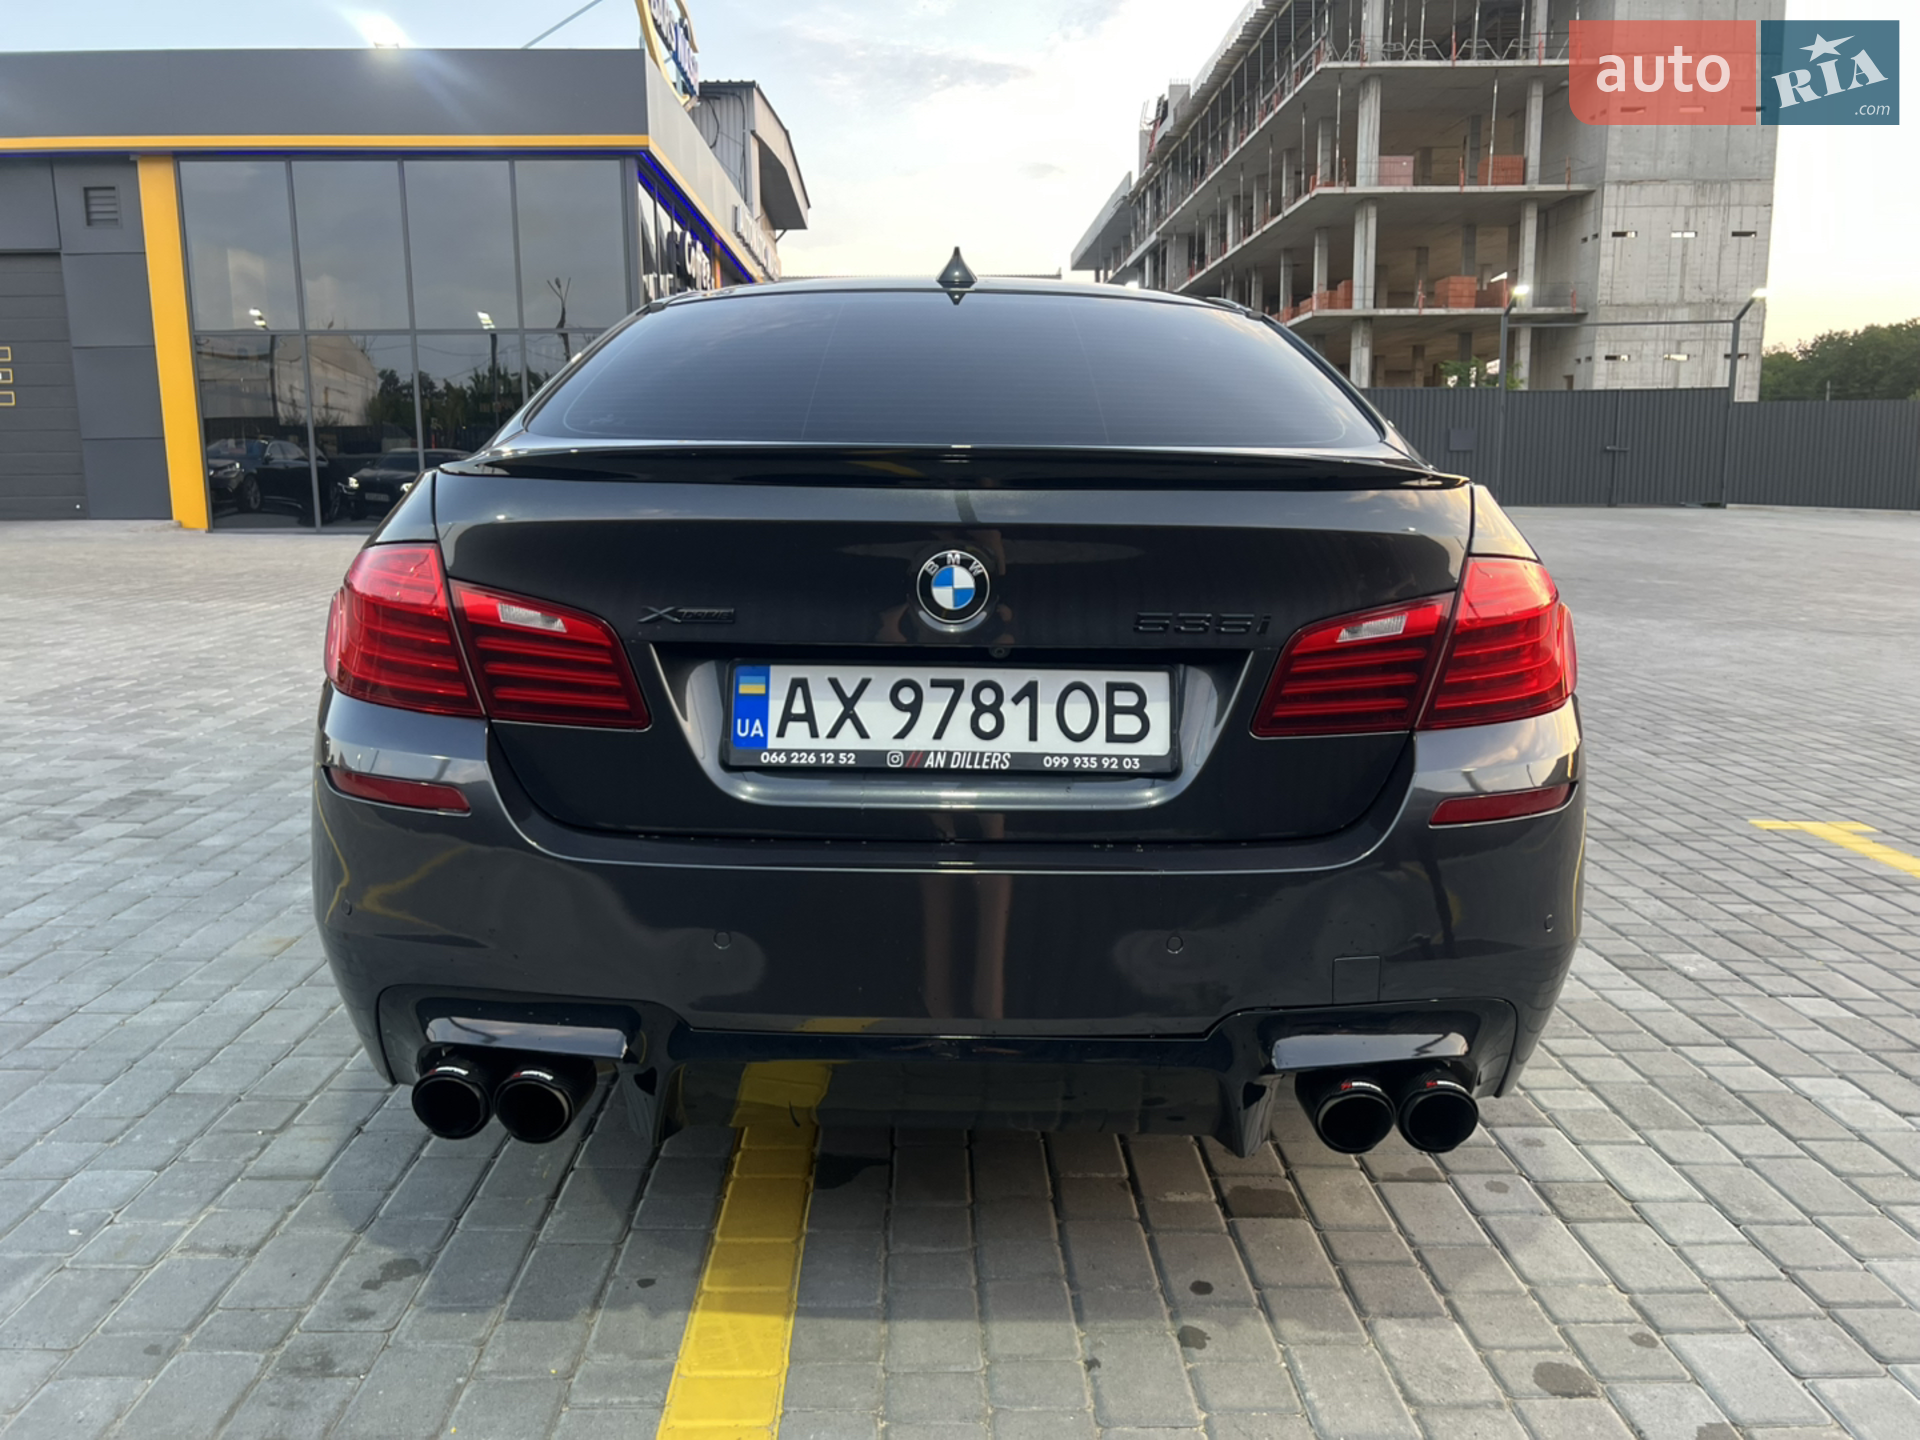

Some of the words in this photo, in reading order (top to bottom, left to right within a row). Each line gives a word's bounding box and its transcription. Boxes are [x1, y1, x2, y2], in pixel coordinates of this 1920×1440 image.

[924, 552, 984, 576] BMW
[776, 677, 872, 739] AX
[889, 678, 1038, 742] 9781
[737, 718, 764, 738] UA
[760, 752, 787, 764] 066
[790, 752, 817, 764] 226
[820, 752, 835, 764] 12
[838, 753, 856, 765] 52
[951, 751, 1011, 770] DILLERS
[1043, 756, 1069, 768] 099
[1073, 757, 1098, 769] 935
[1101, 757, 1119, 769] 92
[1122, 758, 1140, 769] 03
